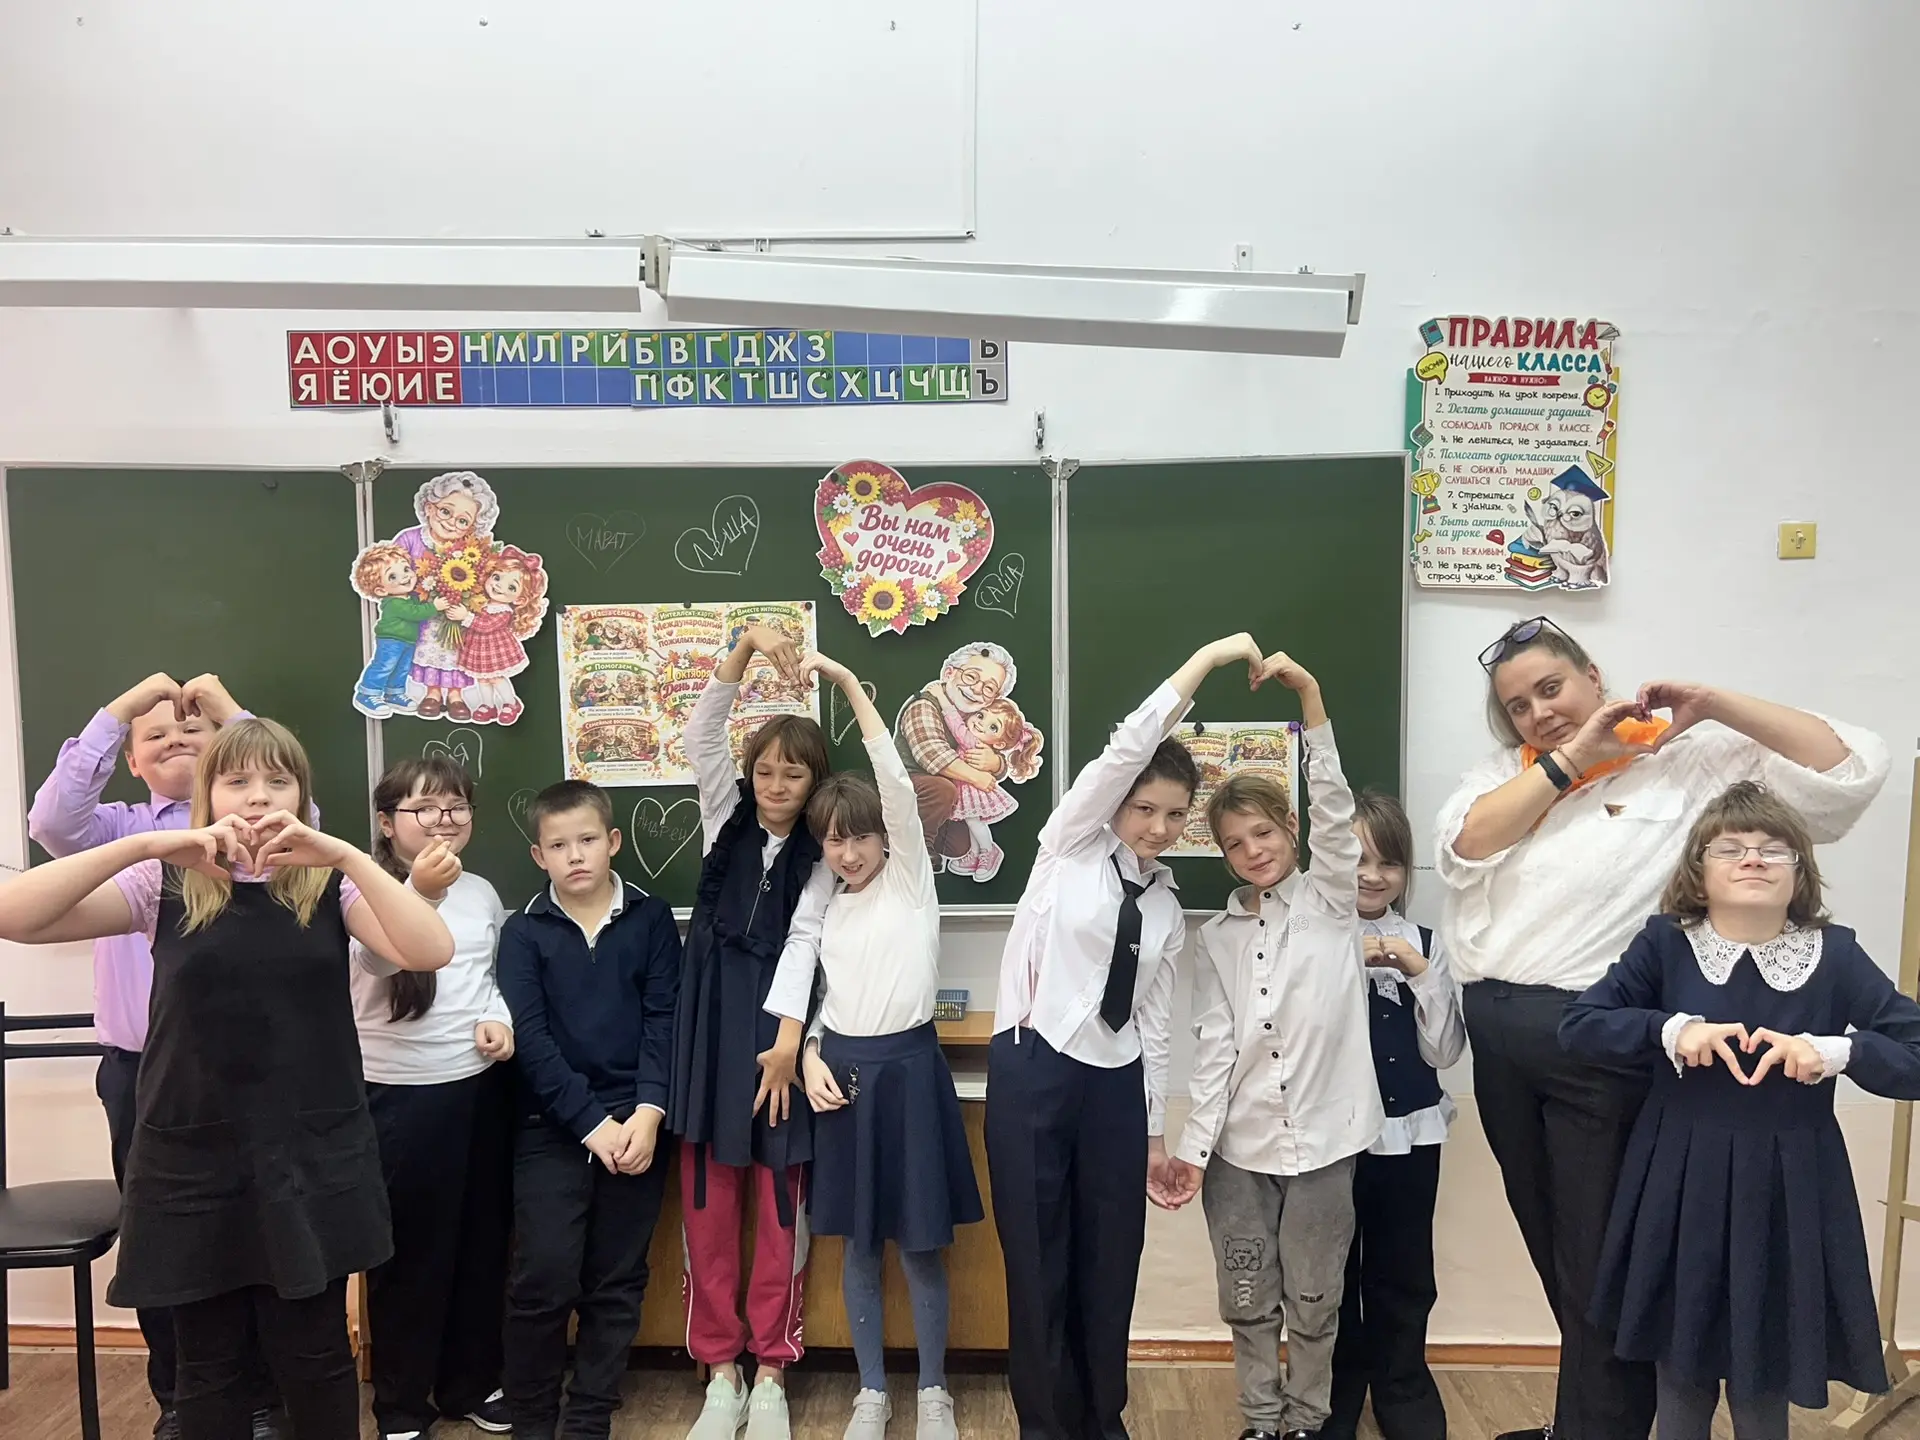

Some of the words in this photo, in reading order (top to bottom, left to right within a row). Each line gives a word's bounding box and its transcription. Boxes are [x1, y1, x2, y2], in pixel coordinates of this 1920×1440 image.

[1449, 318, 1598, 349] ПРАВИЛА
[1450, 353, 1513, 369] нашего
[1517, 352, 1601, 372] КЛАССА
[1445, 388, 1494, 398] Приходить
[1515, 390, 1538, 400] урок
[1541, 391, 1580, 400] вовремя.
[1436, 404, 1444, 413] 2.
[1448, 403, 1488, 414] Делать
[1491, 405, 1545, 419] домашние
[1548, 407, 1594, 420] задания.
[1429, 420, 1435, 428] 3.
[1441, 420, 1492, 430] СОБЛЮДАТЬ
[1500, 421, 1539, 431] ПОРЯДОК
[1559, 424, 1593, 433] КЛАССЕ.
[1453, 436, 1463, 444] Не
[1468, 437, 1514, 446] лениться,
[1535, 439, 1591, 448] задаваться.
[1427, 449, 1436, 459] 5.
[1440, 449, 1492, 461] Помогать
[1494, 450, 1583, 464] одноклассникам.
[1439, 465, 1447, 473] 6.
[1453, 465, 1462, 473] НЕ
[1471, 466, 1507, 475] ОБИЖАТЬ
[1516, 468, 1556, 476] МЛАДШИХ.
[1446, 477, 1490, 485] СЛУШАТЬСЯ
[1499, 477, 1536, 486] СТАРШИХ.
[1448, 491, 1454, 499] 7.
[1458, 492, 1514, 500] Стремиться
[1463, 503, 1503, 512] знаниям.
[858, 504, 899, 531] Вы
[904, 517, 950, 543] нам
[1428, 516, 1436, 526] 8.
[1440, 516, 1469, 527] Быть
[1472, 518, 1528, 528] активным
[873, 533, 935, 559] очень
[1422, 546, 1431, 554] 9.
[1436, 547, 1456, 555] БЫТЬ
[1462, 548, 1507, 557] ВЕЖЛИВЫМ.
[855, 550, 945, 580] дороги!
[1423, 561, 1433, 569] 10.
[1438, 561, 1449, 569] Не
[1454, 562, 1482, 571] брать
[1487, 563, 1502, 573] без
[1428, 573, 1460, 583] спросу
[1466, 574, 1498, 583] чужое.
[737, 607, 759, 615] Вместе
[652, 619, 722, 633] Международный
[675, 669, 710, 681] октября
[663, 682, 690, 698] День
